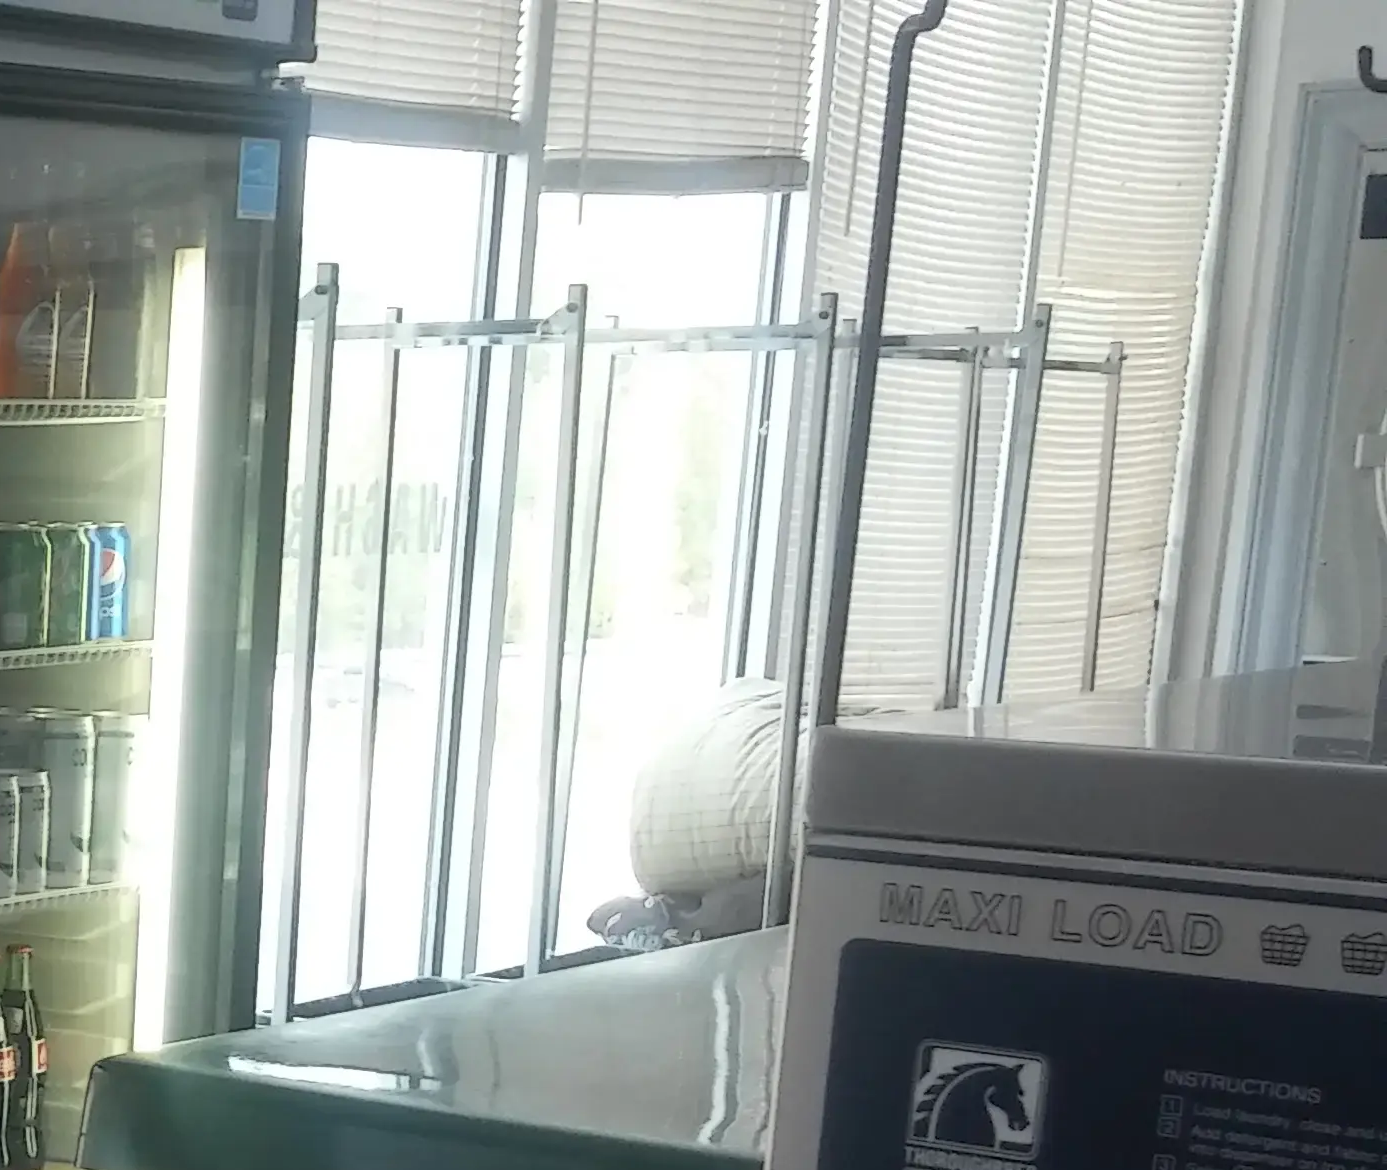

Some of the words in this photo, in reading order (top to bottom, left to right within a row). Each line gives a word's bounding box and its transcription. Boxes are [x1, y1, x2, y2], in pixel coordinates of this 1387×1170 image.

[879, 882, 1023, 938] MAXI
[1049, 898, 1224, 958] LOAD
[1163, 1068, 1322, 1106] INSTRUCTIONS
